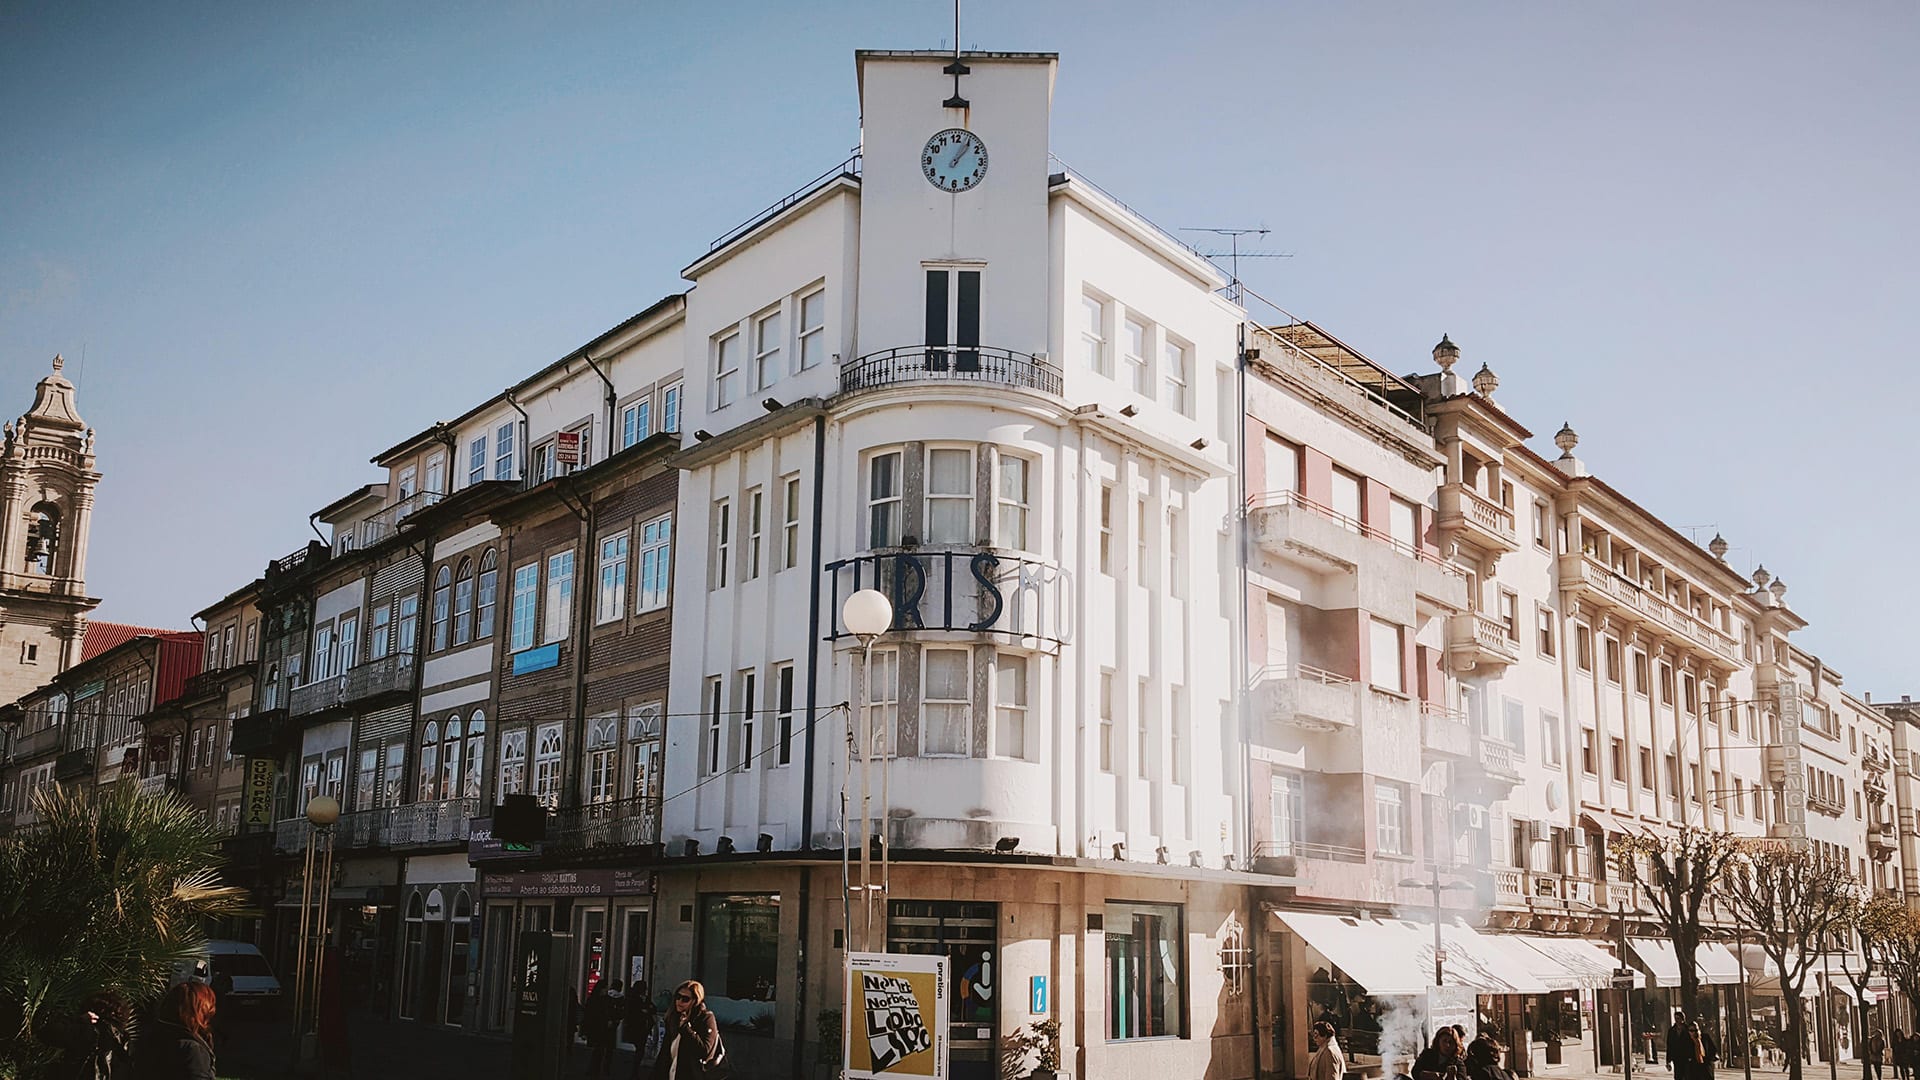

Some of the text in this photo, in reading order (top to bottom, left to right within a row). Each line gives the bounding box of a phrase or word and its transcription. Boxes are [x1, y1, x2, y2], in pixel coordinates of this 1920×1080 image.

[939, 138, 947, 146] 11
[951, 134, 961, 143] 12
[931, 145, 940, 154] 10
[974, 146, 980, 154] 2
[926, 156, 932, 165] 9
[978, 158, 984, 167] 3
[930, 168, 936, 177] 8
[973, 169, 979, 178] 4
[940, 176, 946, 185] 7
[951, 180, 957, 189] 6
[964, 177, 970, 186] 5
[249, 760, 267, 823] OURO PRATA
[520, 885, 538, 894] Aberta
[570, 885, 584, 894] todo
[590, 883, 601, 894] dia
[866, 1007, 923, 1036] Lobo
